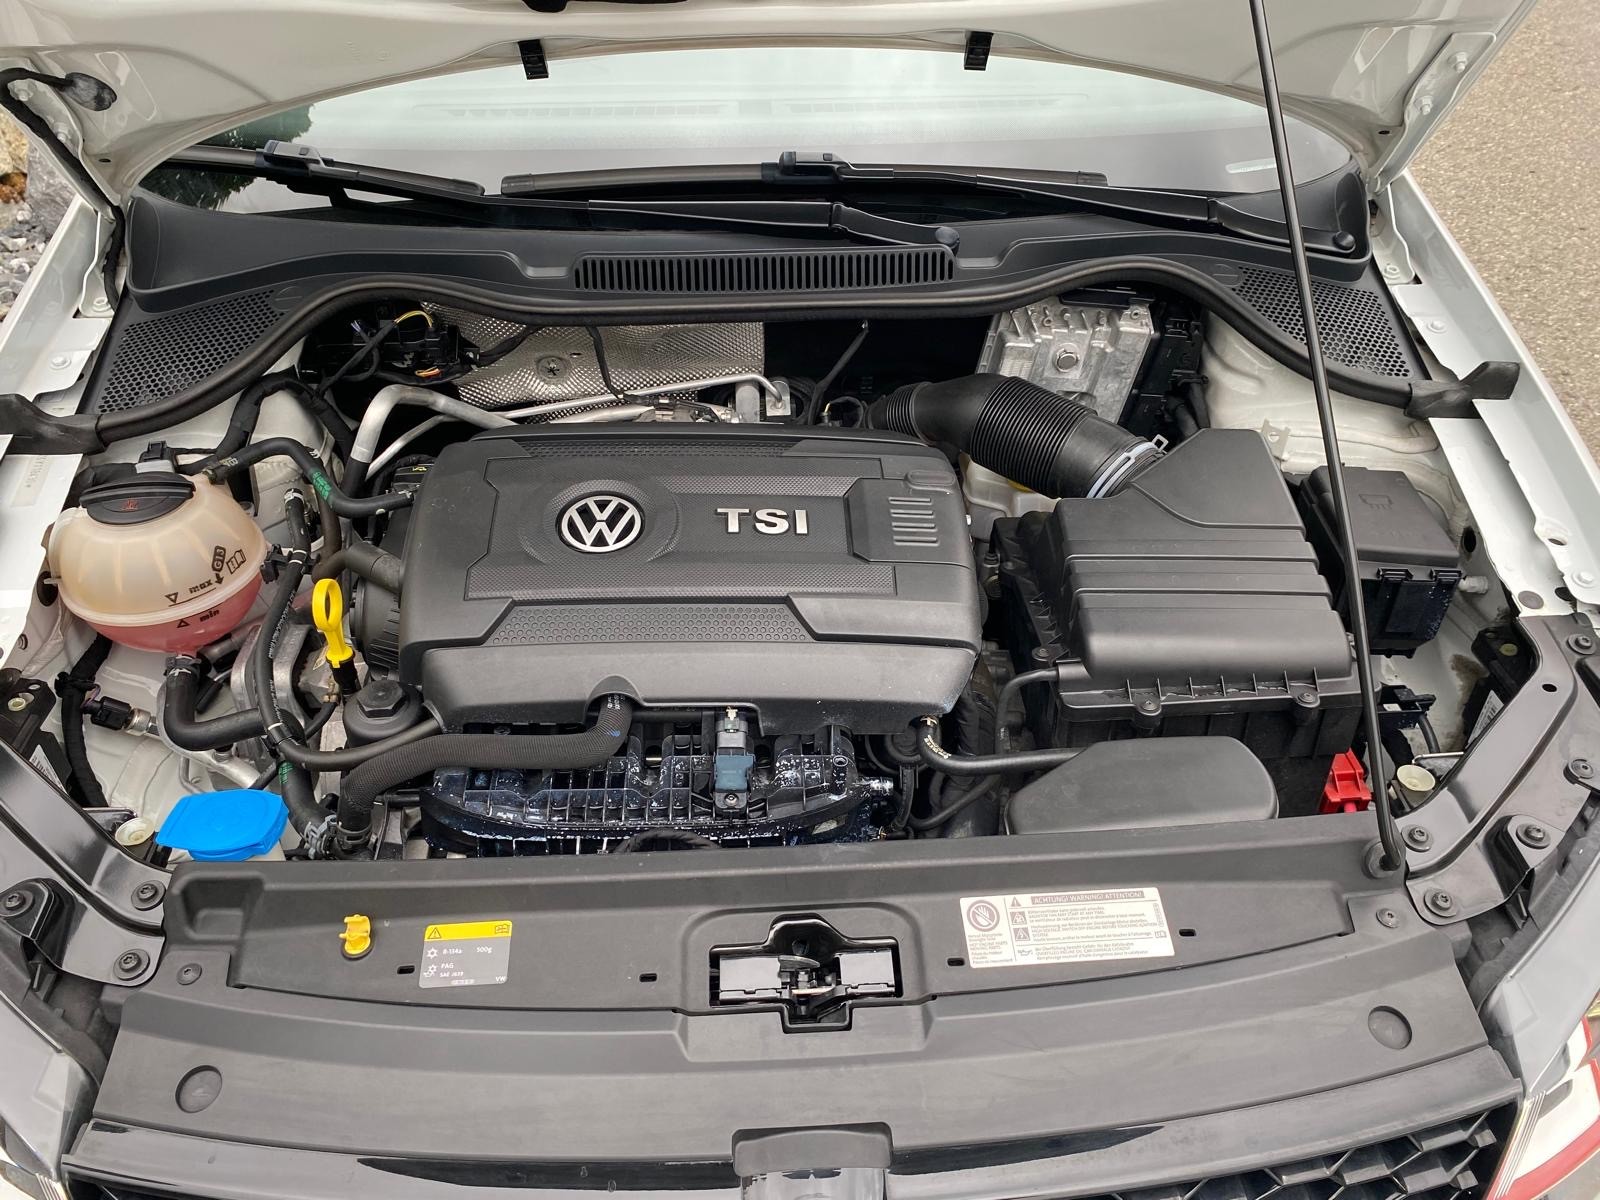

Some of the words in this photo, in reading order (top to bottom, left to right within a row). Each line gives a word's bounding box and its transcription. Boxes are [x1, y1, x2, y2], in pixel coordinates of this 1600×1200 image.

[717, 508, 809, 535] TSI
[214, 548, 225, 569] G13
[189, 579, 213, 594] max
[200, 609, 220, 622] min
[476, 946, 493, 954] 500g
